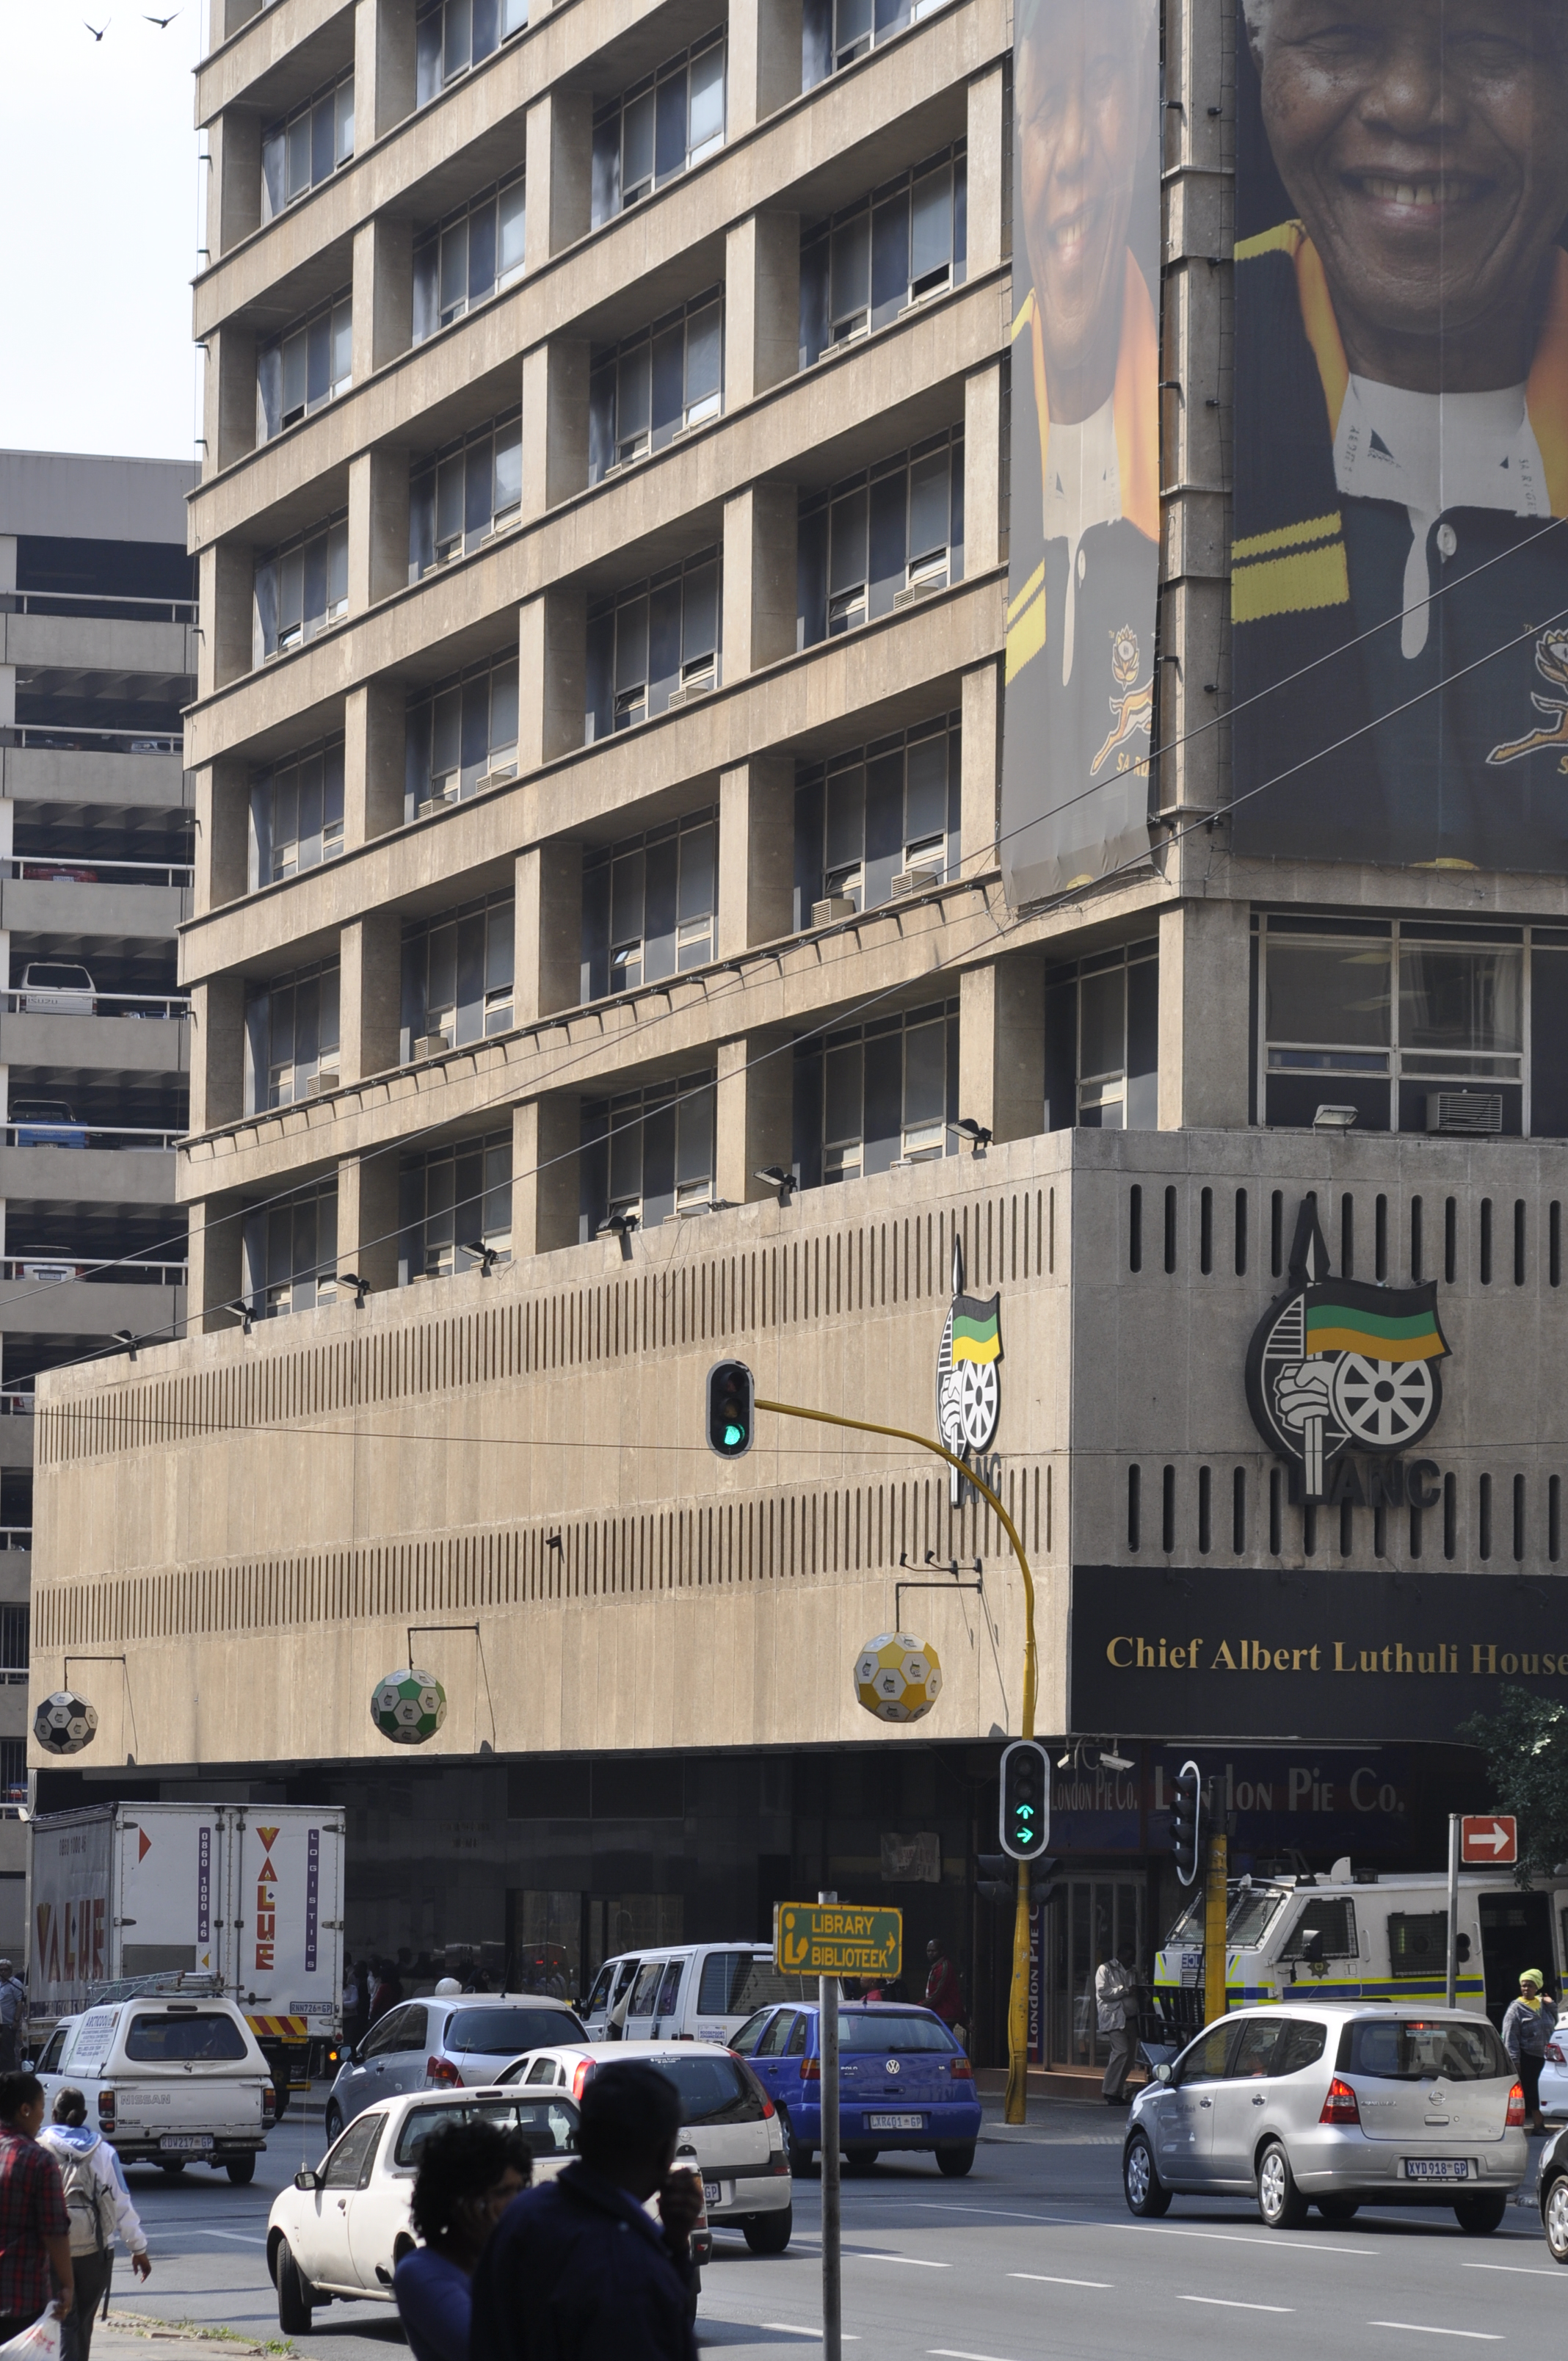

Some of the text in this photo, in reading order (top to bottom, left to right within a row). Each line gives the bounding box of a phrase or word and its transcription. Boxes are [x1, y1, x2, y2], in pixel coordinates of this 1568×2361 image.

[1116, 752, 1130, 772] SA
[960, 1451, 1002, 1505] ANC
[1329, 1458, 1442, 1508] ANC
[1106, 1636, 1568, 1675] Chief Albert Luthuli House
[200, 1832, 208, 1867] 0860
[255, 1827, 281, 1970] VALUE
[307, 1832, 318, 1969] LOGISTICS
[200, 1921, 208, 1937] 46
[812, 1913, 874, 1935] LIBRARY
[37, 1898, 105, 1983] VALUE
[811, 1946, 888, 1968] BIBLIOTEEK
[291, 2004, 331, 2013] RNN726 GP
[120, 2095, 171, 2105] NISSAN
[871, 2117, 922, 2128] LXR401 GP
[161, 2137, 212, 2148] RDW217 GP
[1409, 2162, 1466, 2175] XYD 918 GP
[705, 2186, 717, 2199] GP
